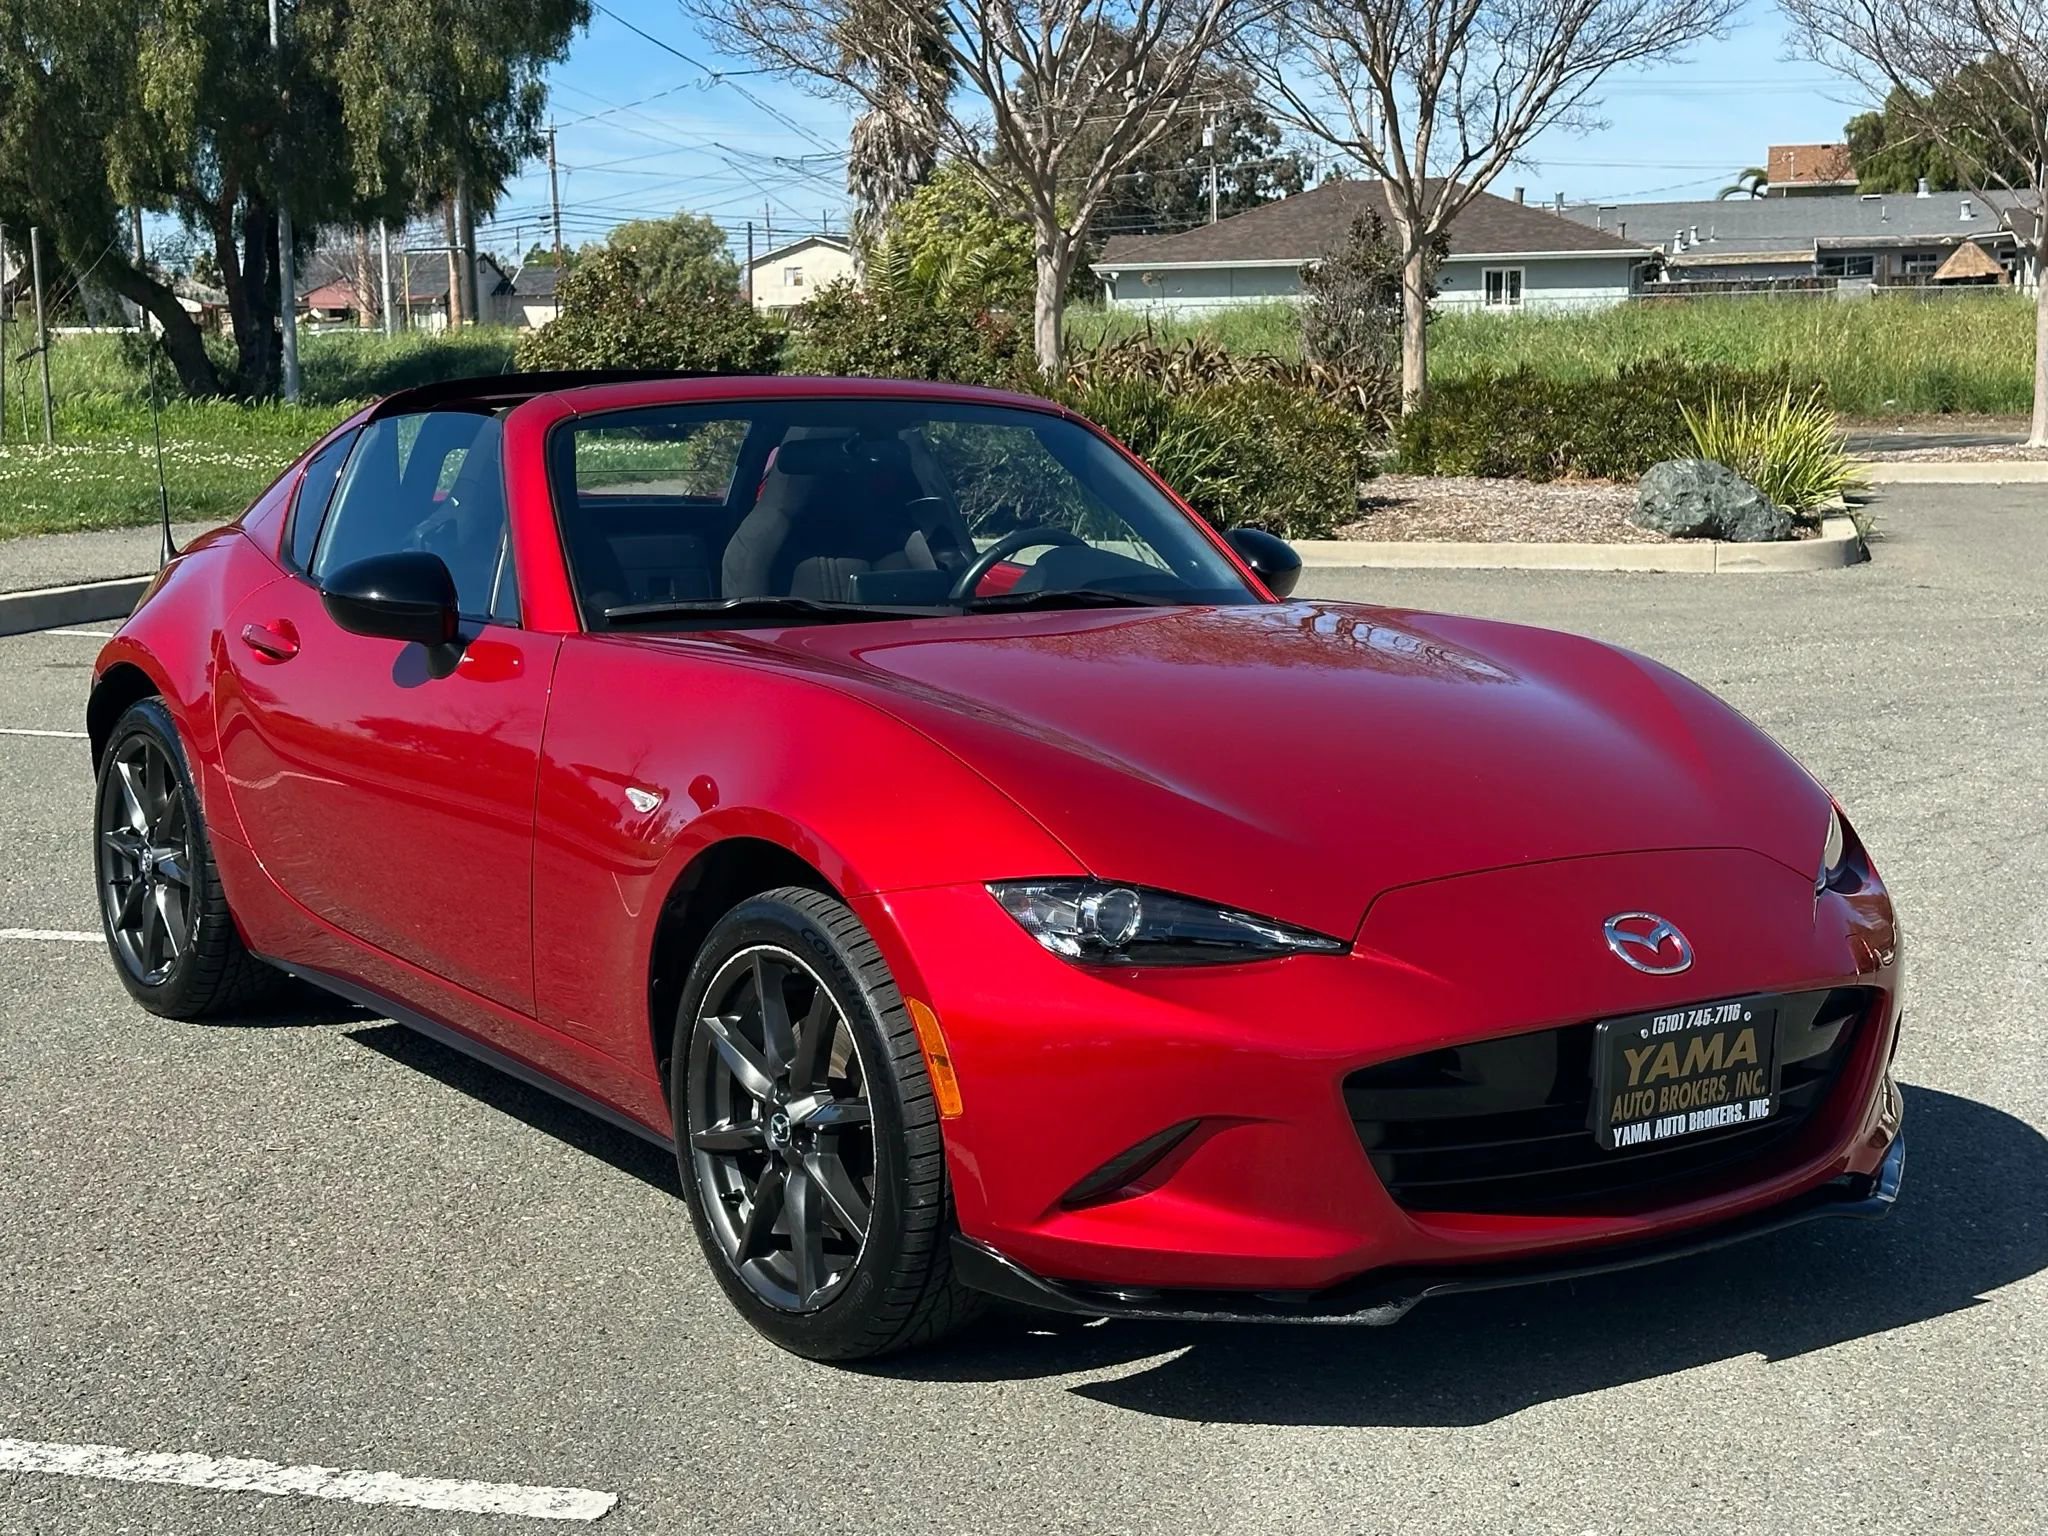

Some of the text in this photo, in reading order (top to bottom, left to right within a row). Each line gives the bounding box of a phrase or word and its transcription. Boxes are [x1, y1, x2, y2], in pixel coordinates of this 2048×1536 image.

[1686, 1003, 1742, 1029] 745-7116
[1624, 1028, 1758, 1087] YAMA
[1611, 1068, 1766, 1122] AUTO BROKERS, INC.
[1613, 1122, 1651, 1147] YAMA
[1655, 1115, 1686, 1139] AUTO
[1748, 1098, 1770, 1119] INC
